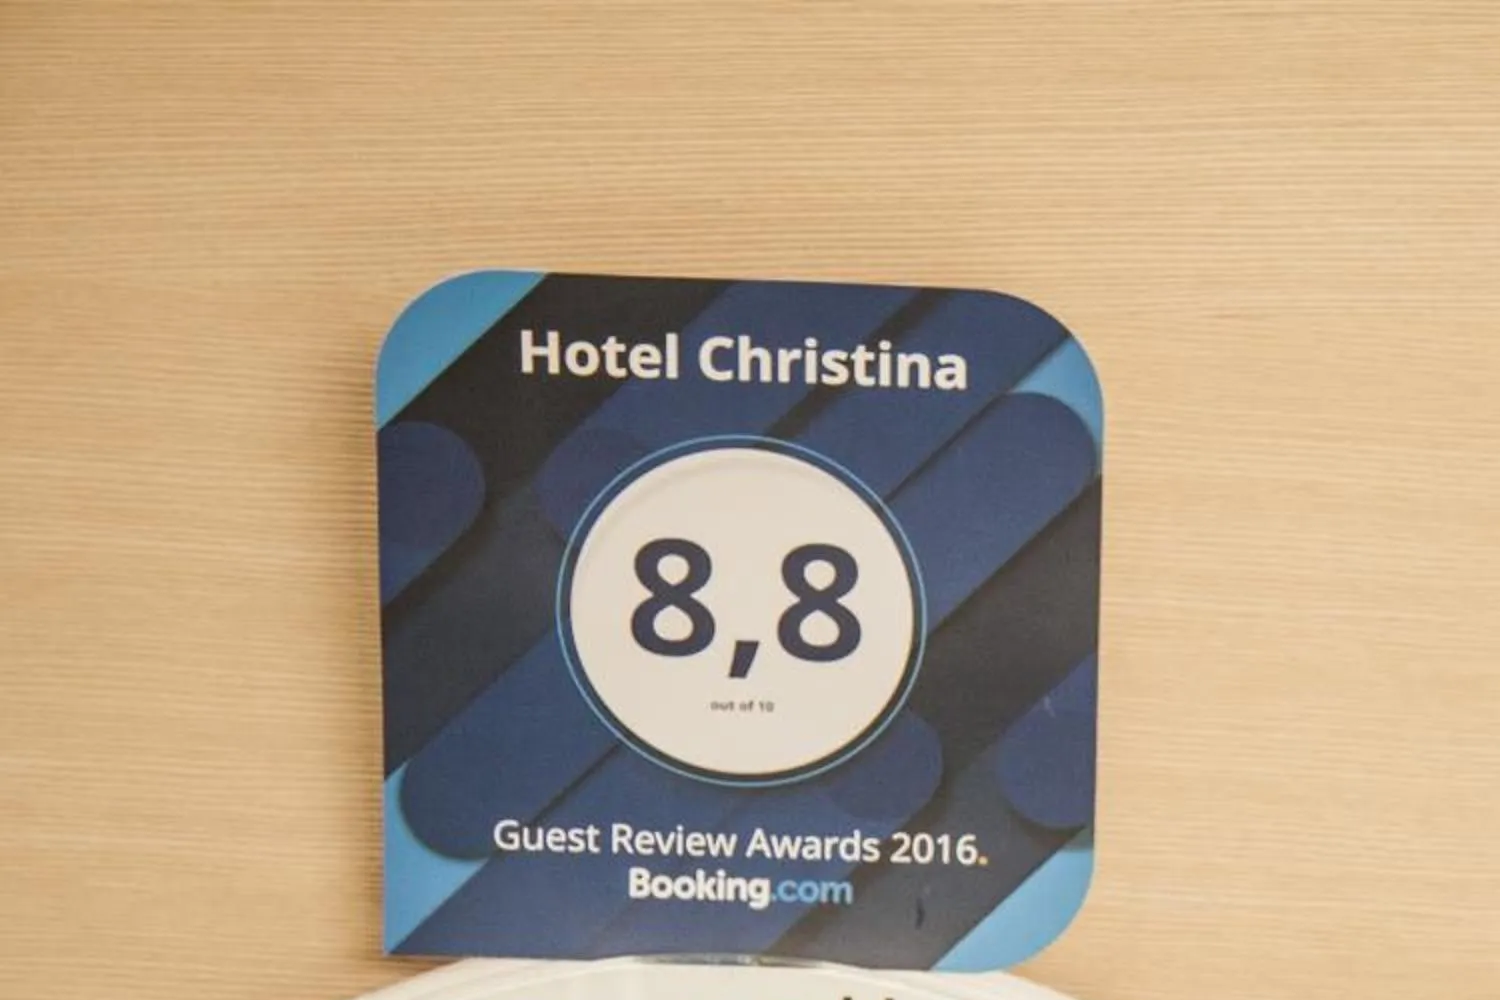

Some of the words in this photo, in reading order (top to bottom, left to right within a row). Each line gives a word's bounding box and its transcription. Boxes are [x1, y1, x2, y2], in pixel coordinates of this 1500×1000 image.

[519, 329, 679, 380] Hotel
[699, 335, 969, 390] Christina
[629, 537, 863, 681] 8,8
[710, 700, 736, 712] out
[740, 700, 755, 713] of
[757, 701, 775, 713] 10
[493, 820, 599, 856] Guest
[610, 823, 740, 858] Review
[746, 827, 880, 863] Awards
[628, 867, 854, 909] Booking.com
